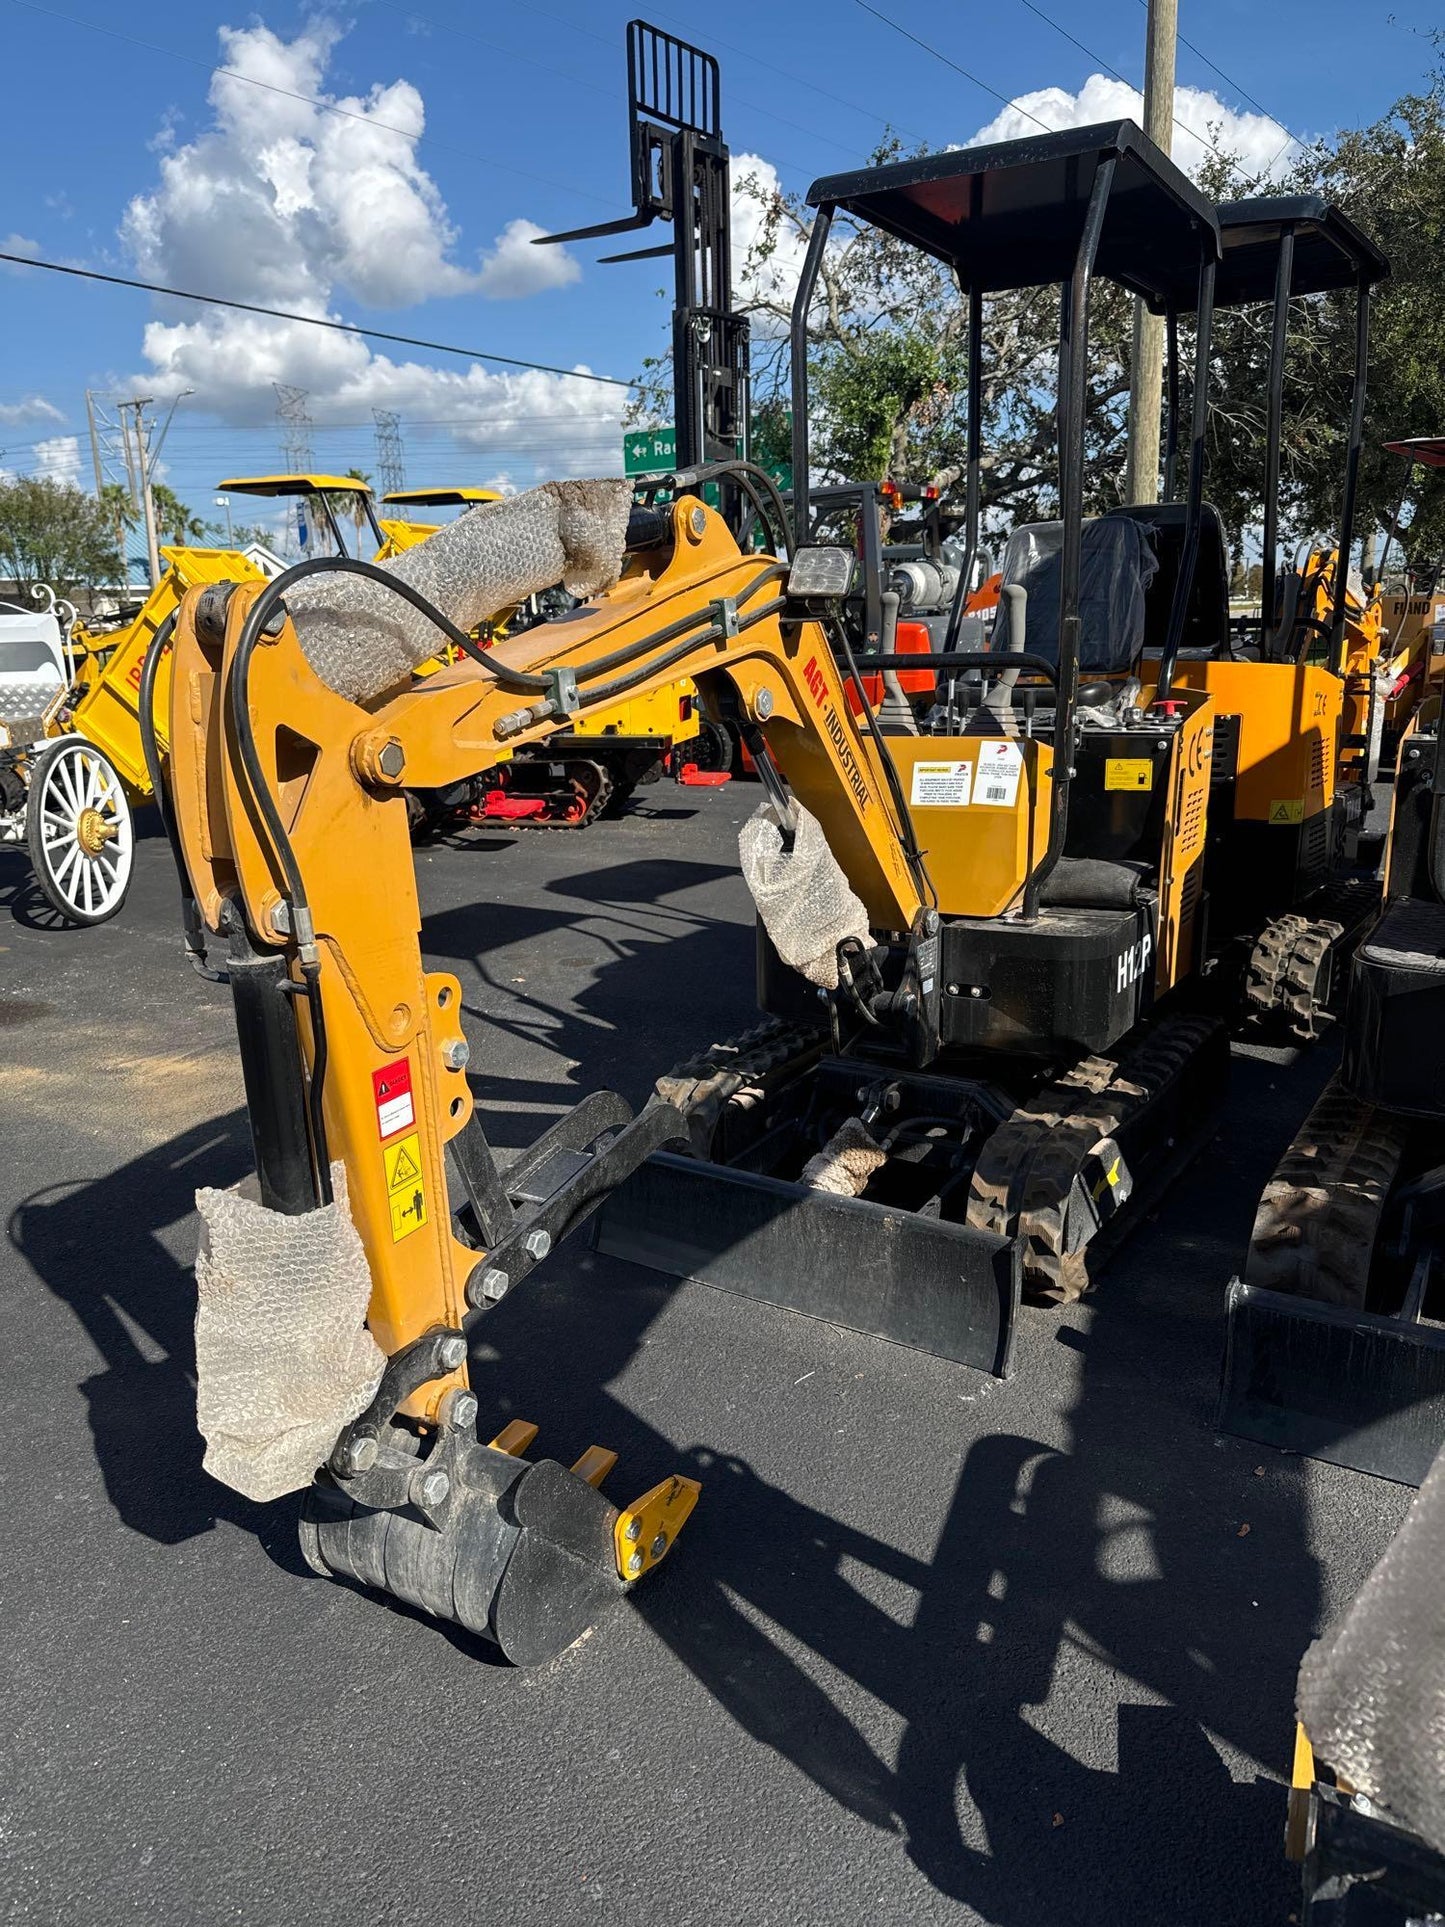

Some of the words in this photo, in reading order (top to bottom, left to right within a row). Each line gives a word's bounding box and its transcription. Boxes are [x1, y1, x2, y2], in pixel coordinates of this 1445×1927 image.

[803, 656, 830, 708] AGT
[825, 708, 871, 812] INDUSTRIAL
[1116, 933, 1151, 994] H12R
